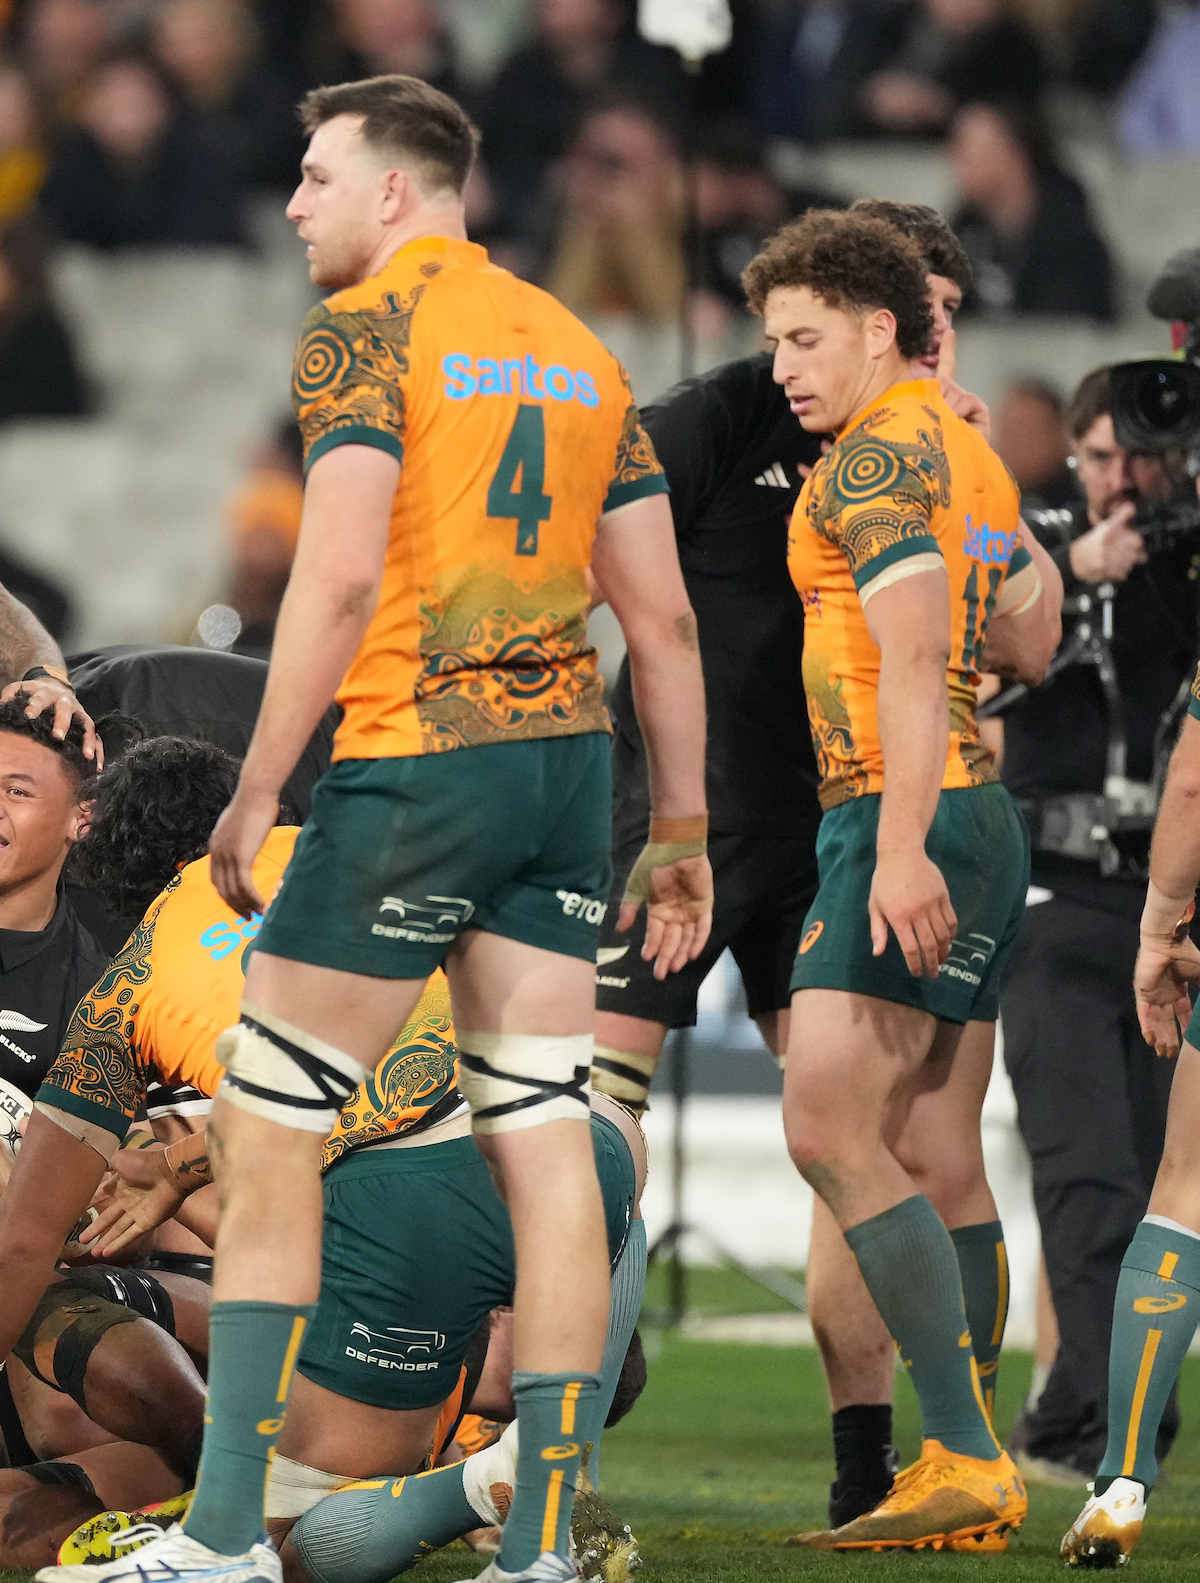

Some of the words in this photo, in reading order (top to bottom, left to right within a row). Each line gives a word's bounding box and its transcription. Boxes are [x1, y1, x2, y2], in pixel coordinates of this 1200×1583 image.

[443, 353, 600, 408] Santos
[486, 403, 553, 556] 4
[345, 1346, 440, 1372] DEFENDER
